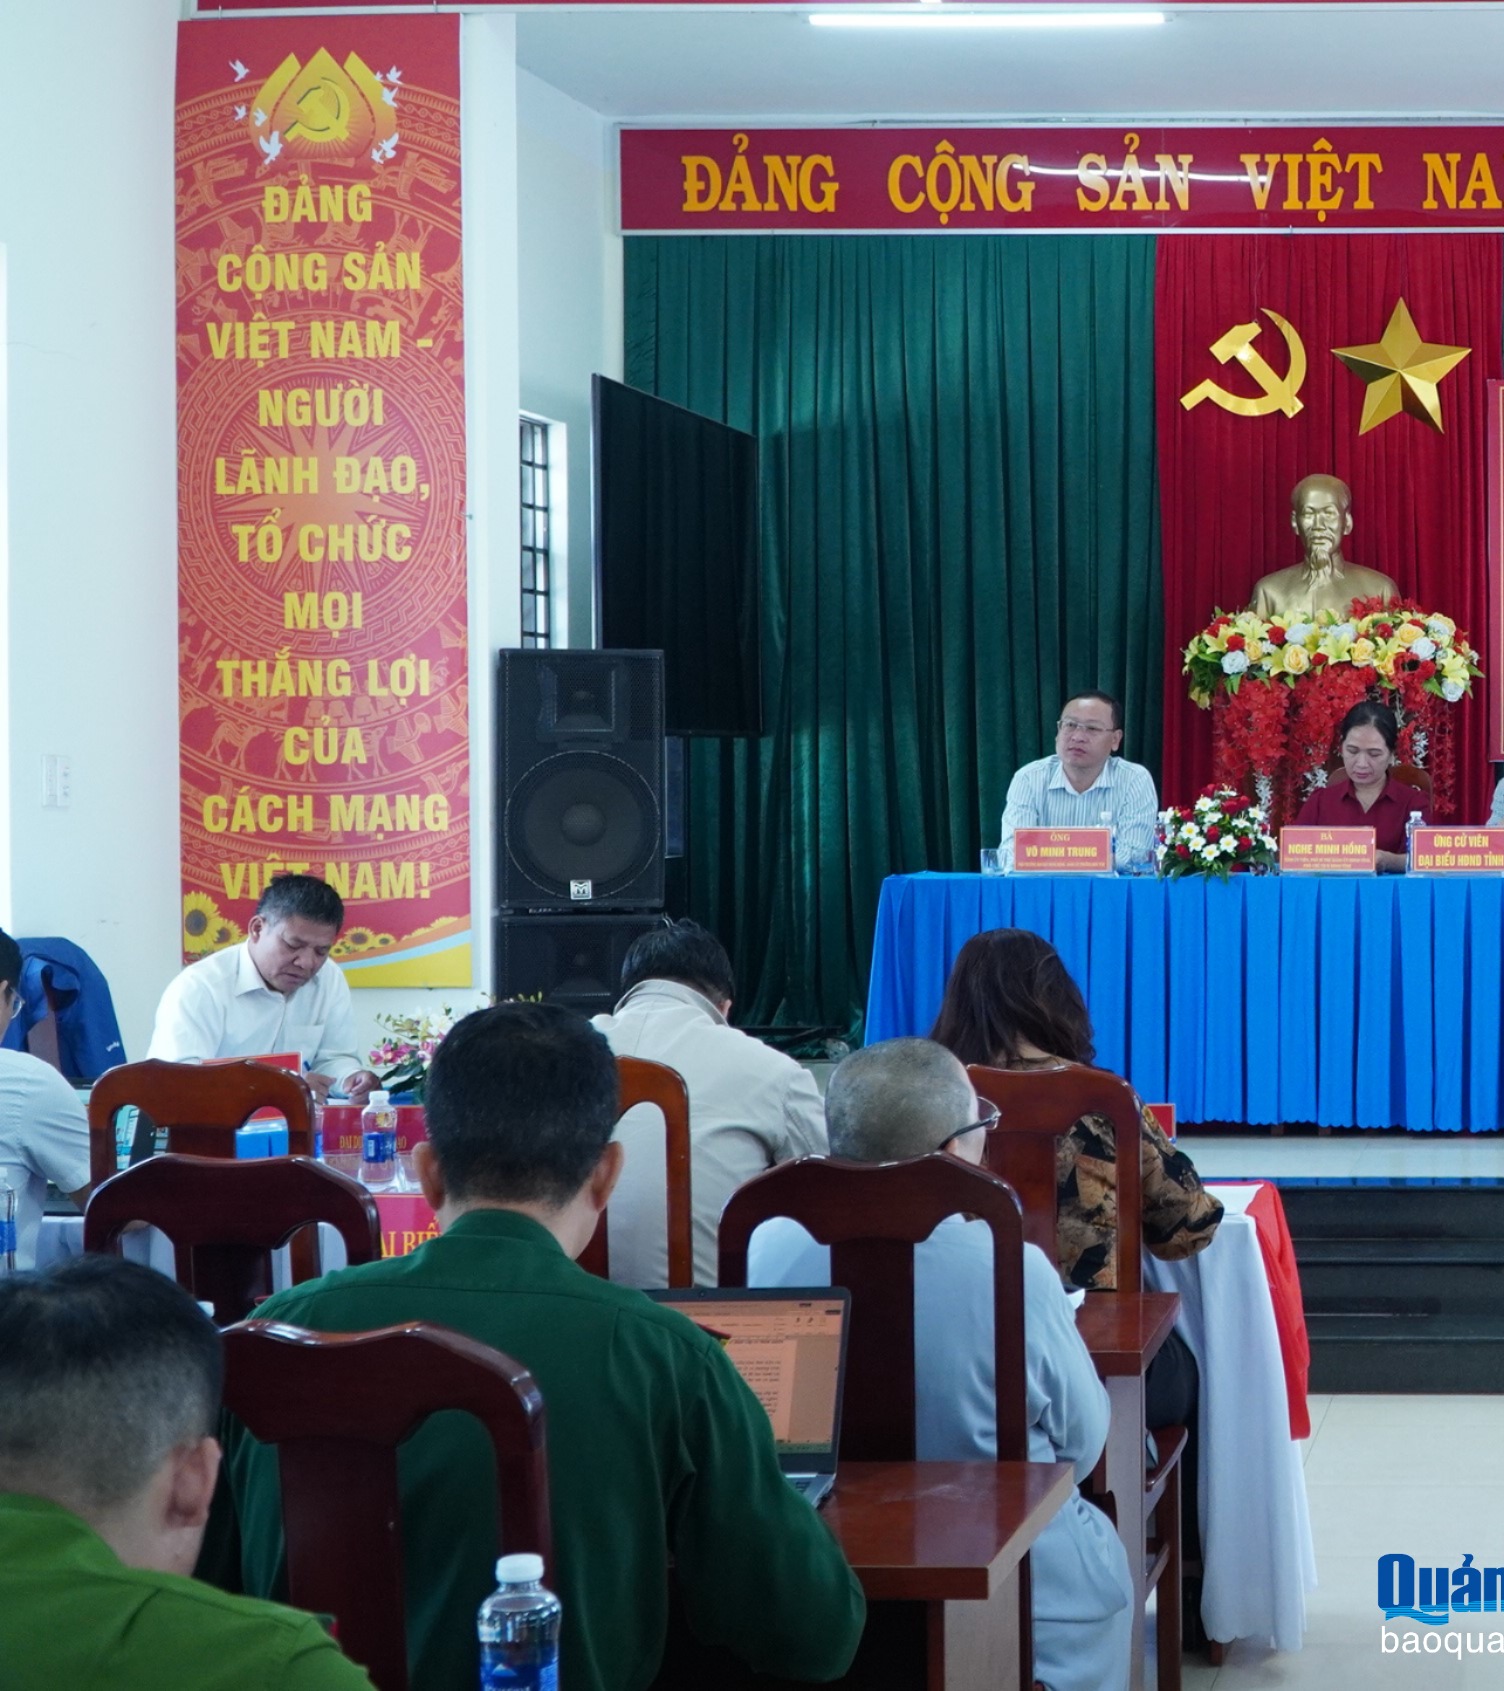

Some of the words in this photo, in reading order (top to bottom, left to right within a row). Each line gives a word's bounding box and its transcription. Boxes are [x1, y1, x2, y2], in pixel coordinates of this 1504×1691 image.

[262, 174, 372, 223] ĐẢNG
[681, 133, 839, 212] ĐẢNG
[887, 139, 1035, 225] CỘNG
[1076, 133, 1193, 212] SẢN
[1240, 137, 1383, 222] VIỆT
[217, 245, 327, 300] CỘNG
[343, 241, 421, 290] SẢN
[206, 312, 295, 368] VIỆT
[310, 321, 400, 358] NAM
[258, 379, 384, 427] NGƯỜI
[215, 449, 318, 495] LÃNH
[333, 456, 431, 502] ĐẠO,
[231, 508, 283, 563] TỔ
[299, 515, 412, 563] CHỨC
[283, 591, 363, 638] MỌI
[216, 646, 351, 698] THẮNG
[370, 656, 430, 705] LỢI
[283, 715, 367, 765] CỦA
[202, 786, 312, 832] CÁCH
[330, 793, 448, 840] MẠNG
[1040, 846, 1065, 858] MINH
[1067, 846, 1098, 858] TRUNG
[1315, 844, 1340, 855] MINH
[1418, 854, 1434, 869] ĐẠI
[1435, 850, 1456, 867] BIỂU
[1468, 833, 1489, 848] VIÊN
[324, 861, 431, 899] NAM!
